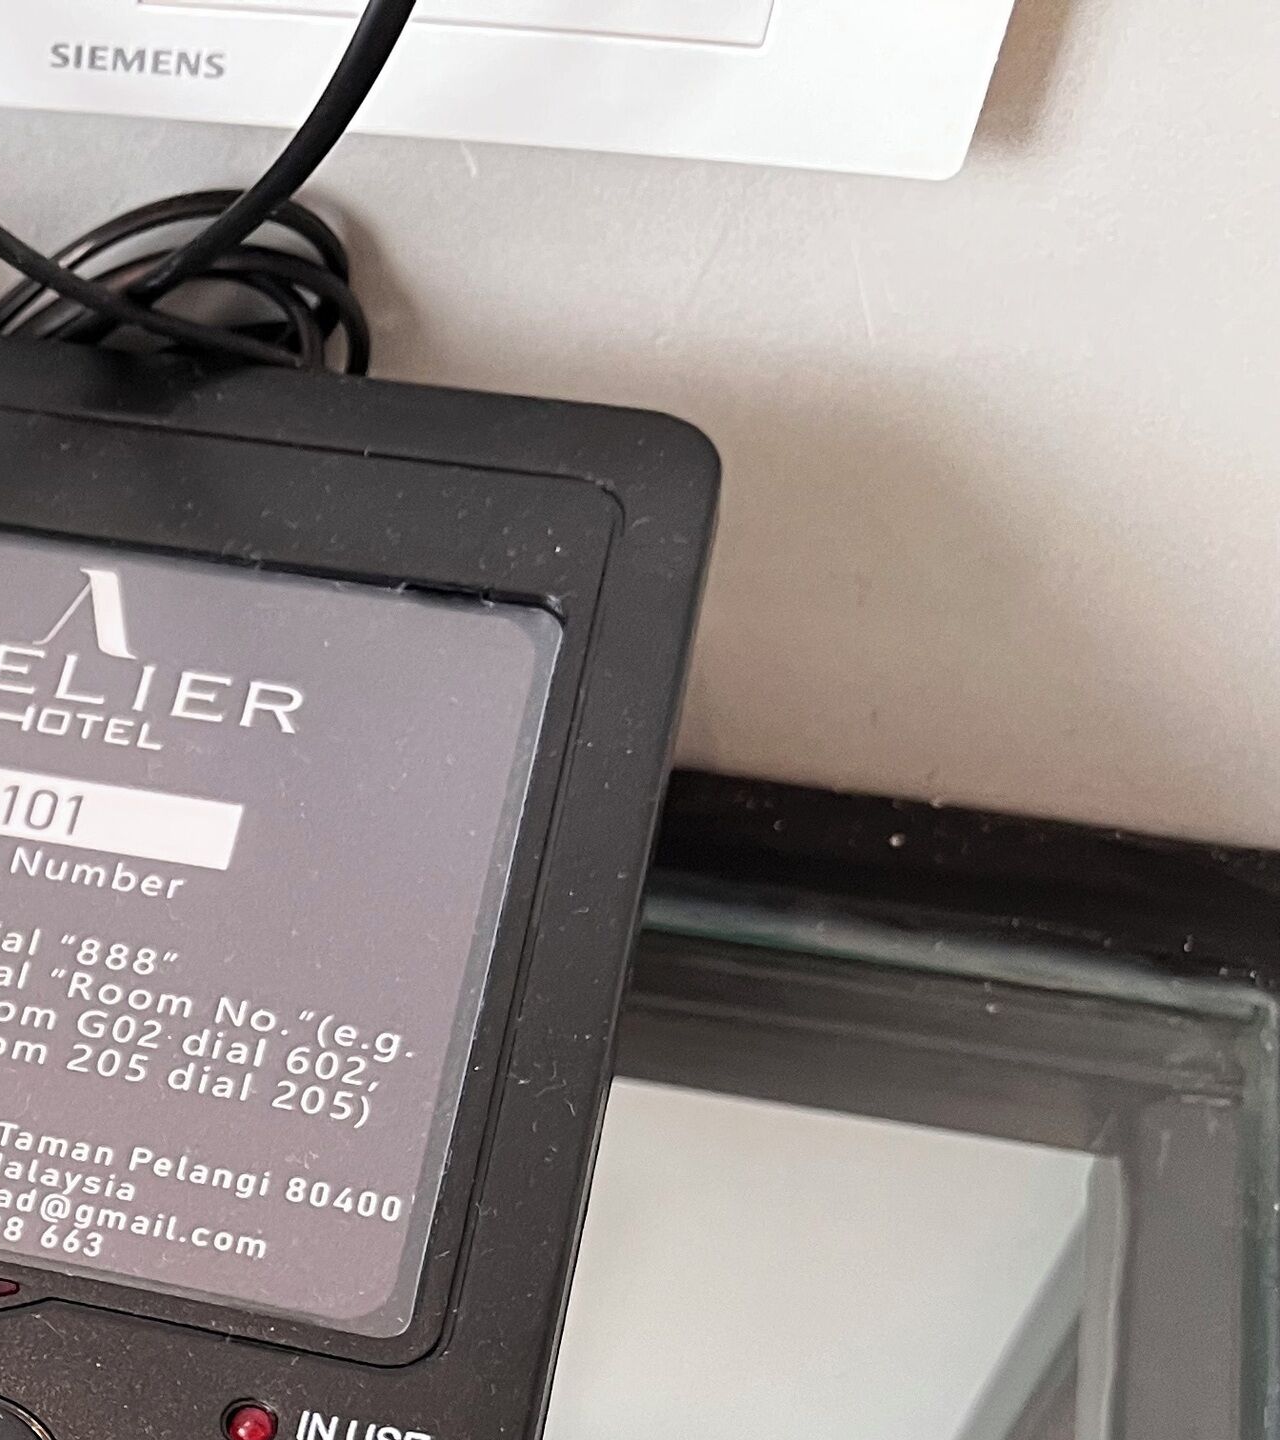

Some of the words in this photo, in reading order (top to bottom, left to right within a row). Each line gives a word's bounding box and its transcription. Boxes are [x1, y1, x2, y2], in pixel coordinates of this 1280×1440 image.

[50, 41, 227, 80] SIEMENS
[1, 784, 85, 837] 101
[11, 850, 187, 900] Number
[77, 1010, 161, 1049] G02
[182, 1028, 267, 1067] dial
[286, 1047, 380, 1093] 602,
[67, 1044, 148, 1082] 205
[168, 1063, 253, 1101] dial
[271, 1080, 371, 1130] 205)
[129, 1147, 271, 1199] Pelangi
[285, 1177, 403, 1223] 80400
[40, 1226, 104, 1258] 663
